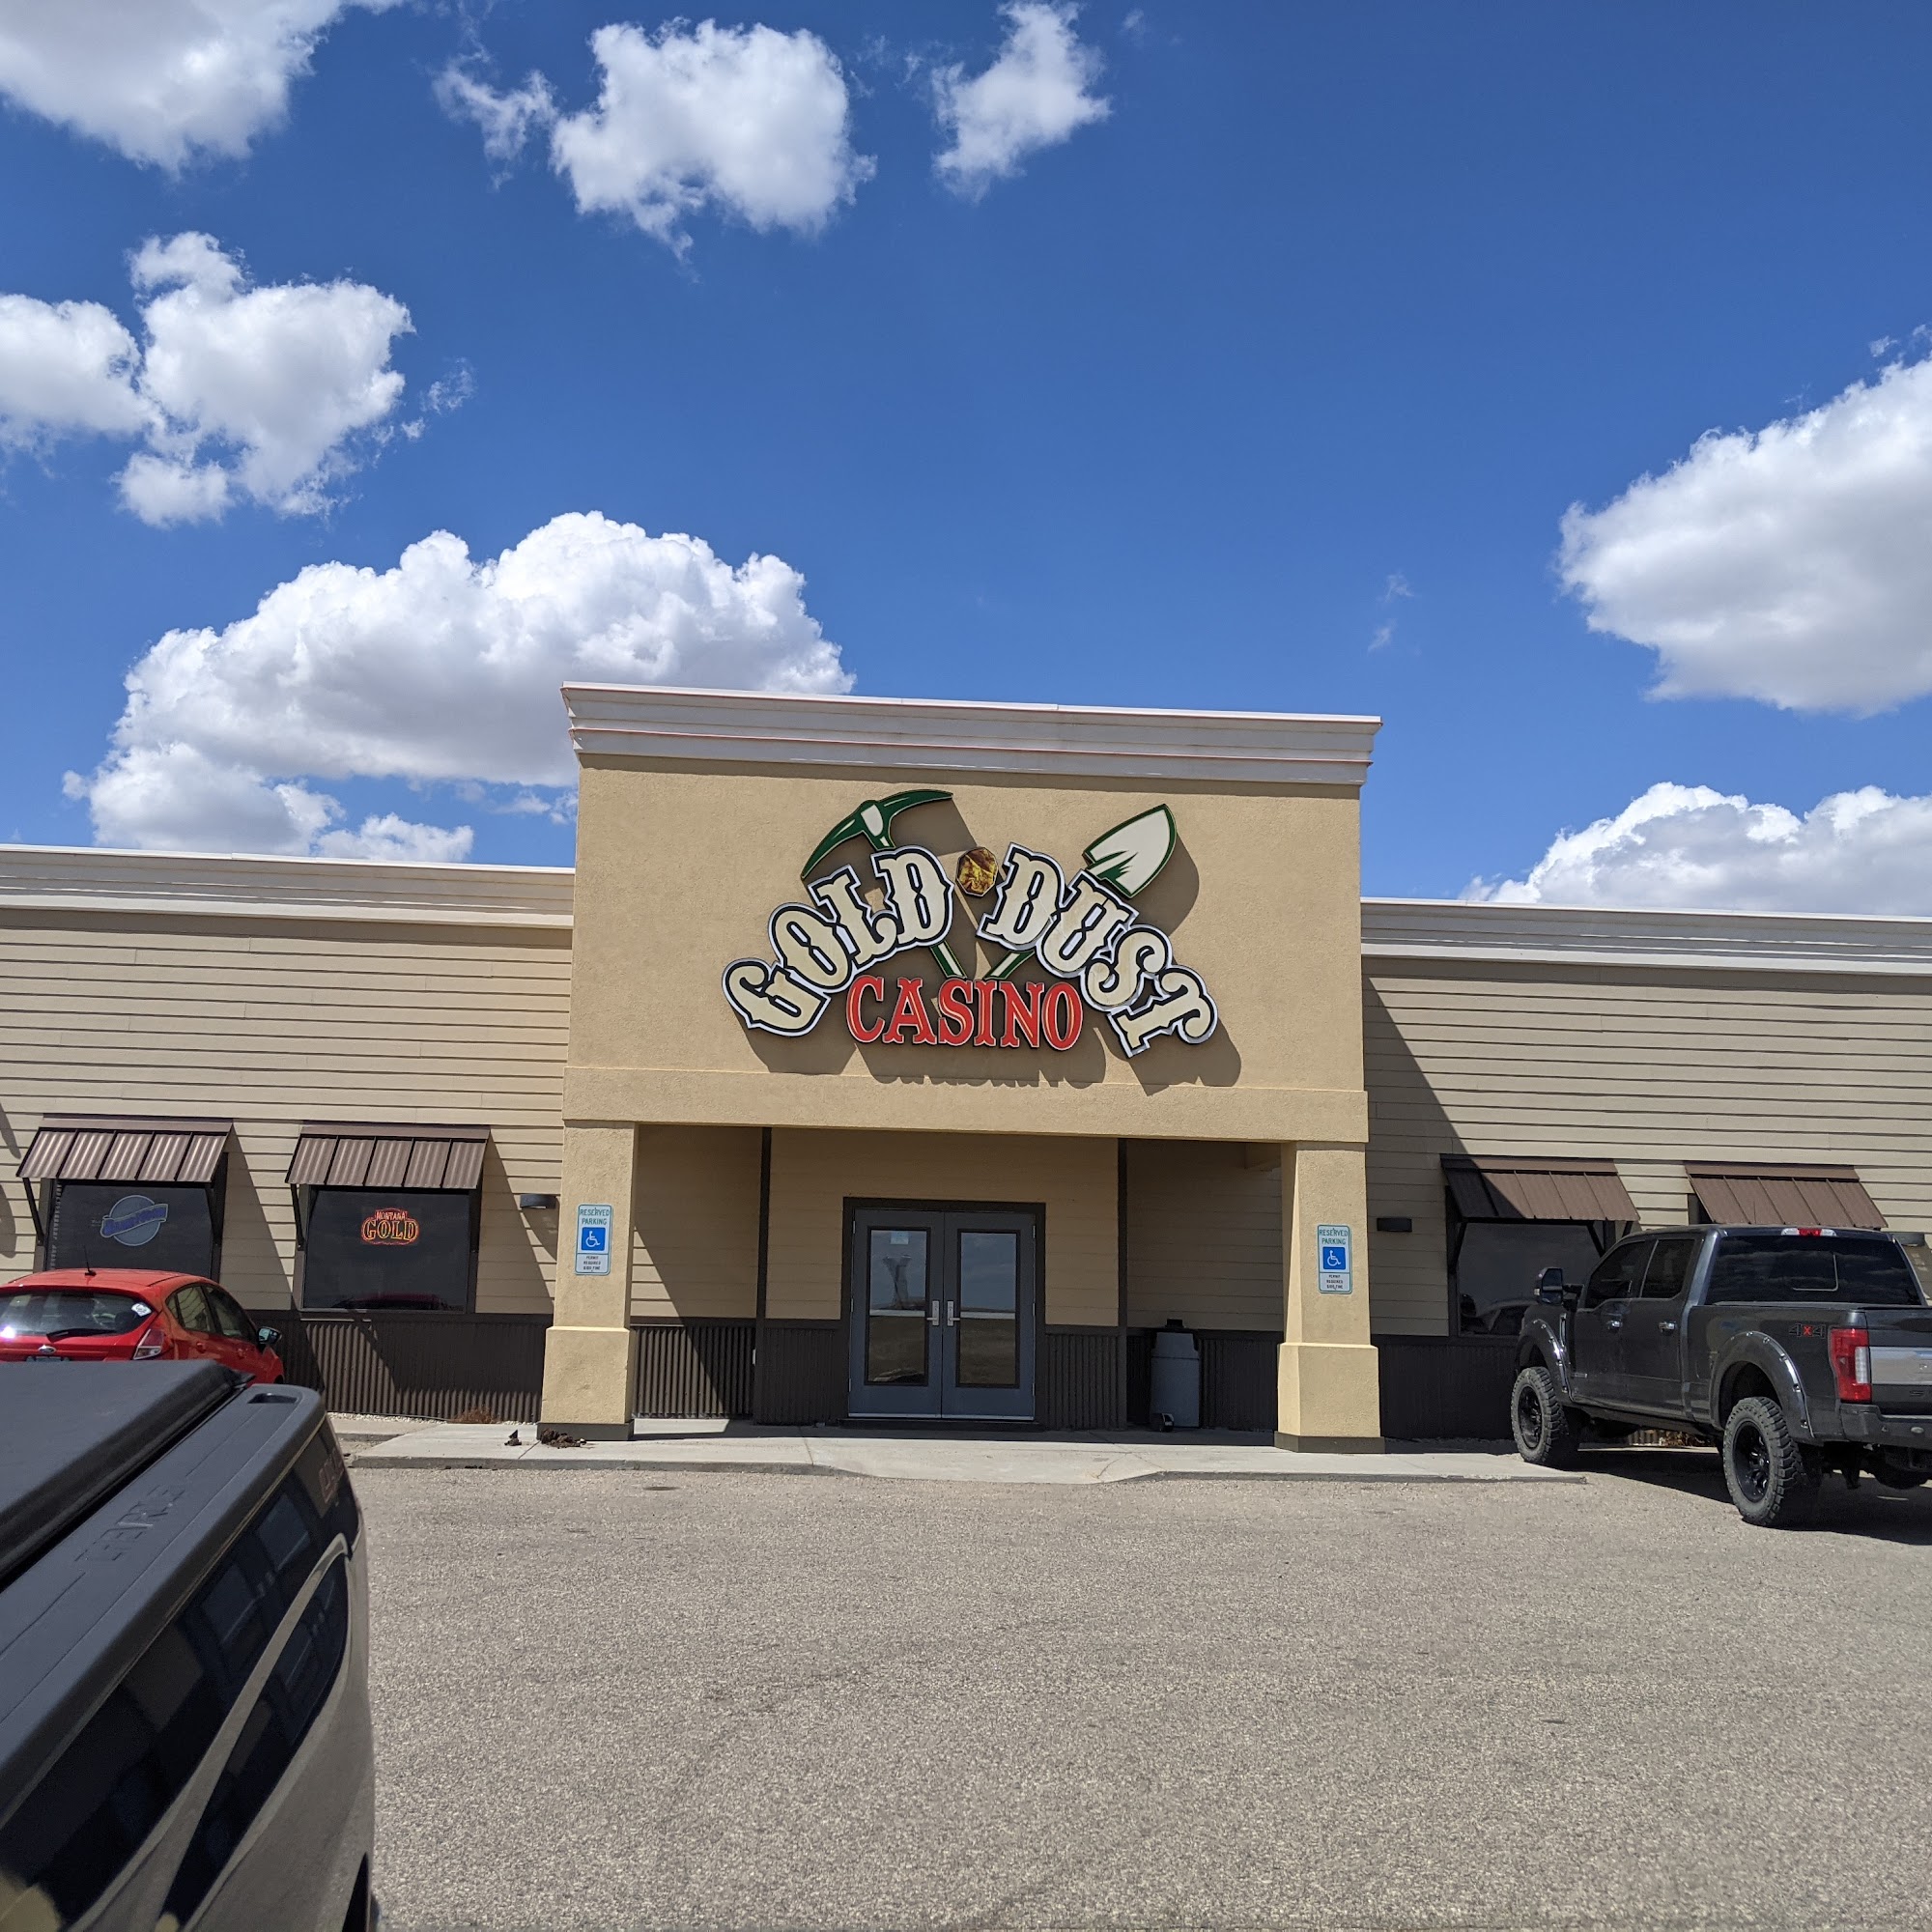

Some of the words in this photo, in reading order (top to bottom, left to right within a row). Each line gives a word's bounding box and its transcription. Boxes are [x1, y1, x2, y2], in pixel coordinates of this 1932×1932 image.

[723, 845, 952, 1037] GOLD
[976, 842, 1217, 1058] DUST
[846, 976, 1082, 1050] CASINO
[362, 1219, 418, 1240] GOLD
[376, 1211, 406, 1220] MONTANA
